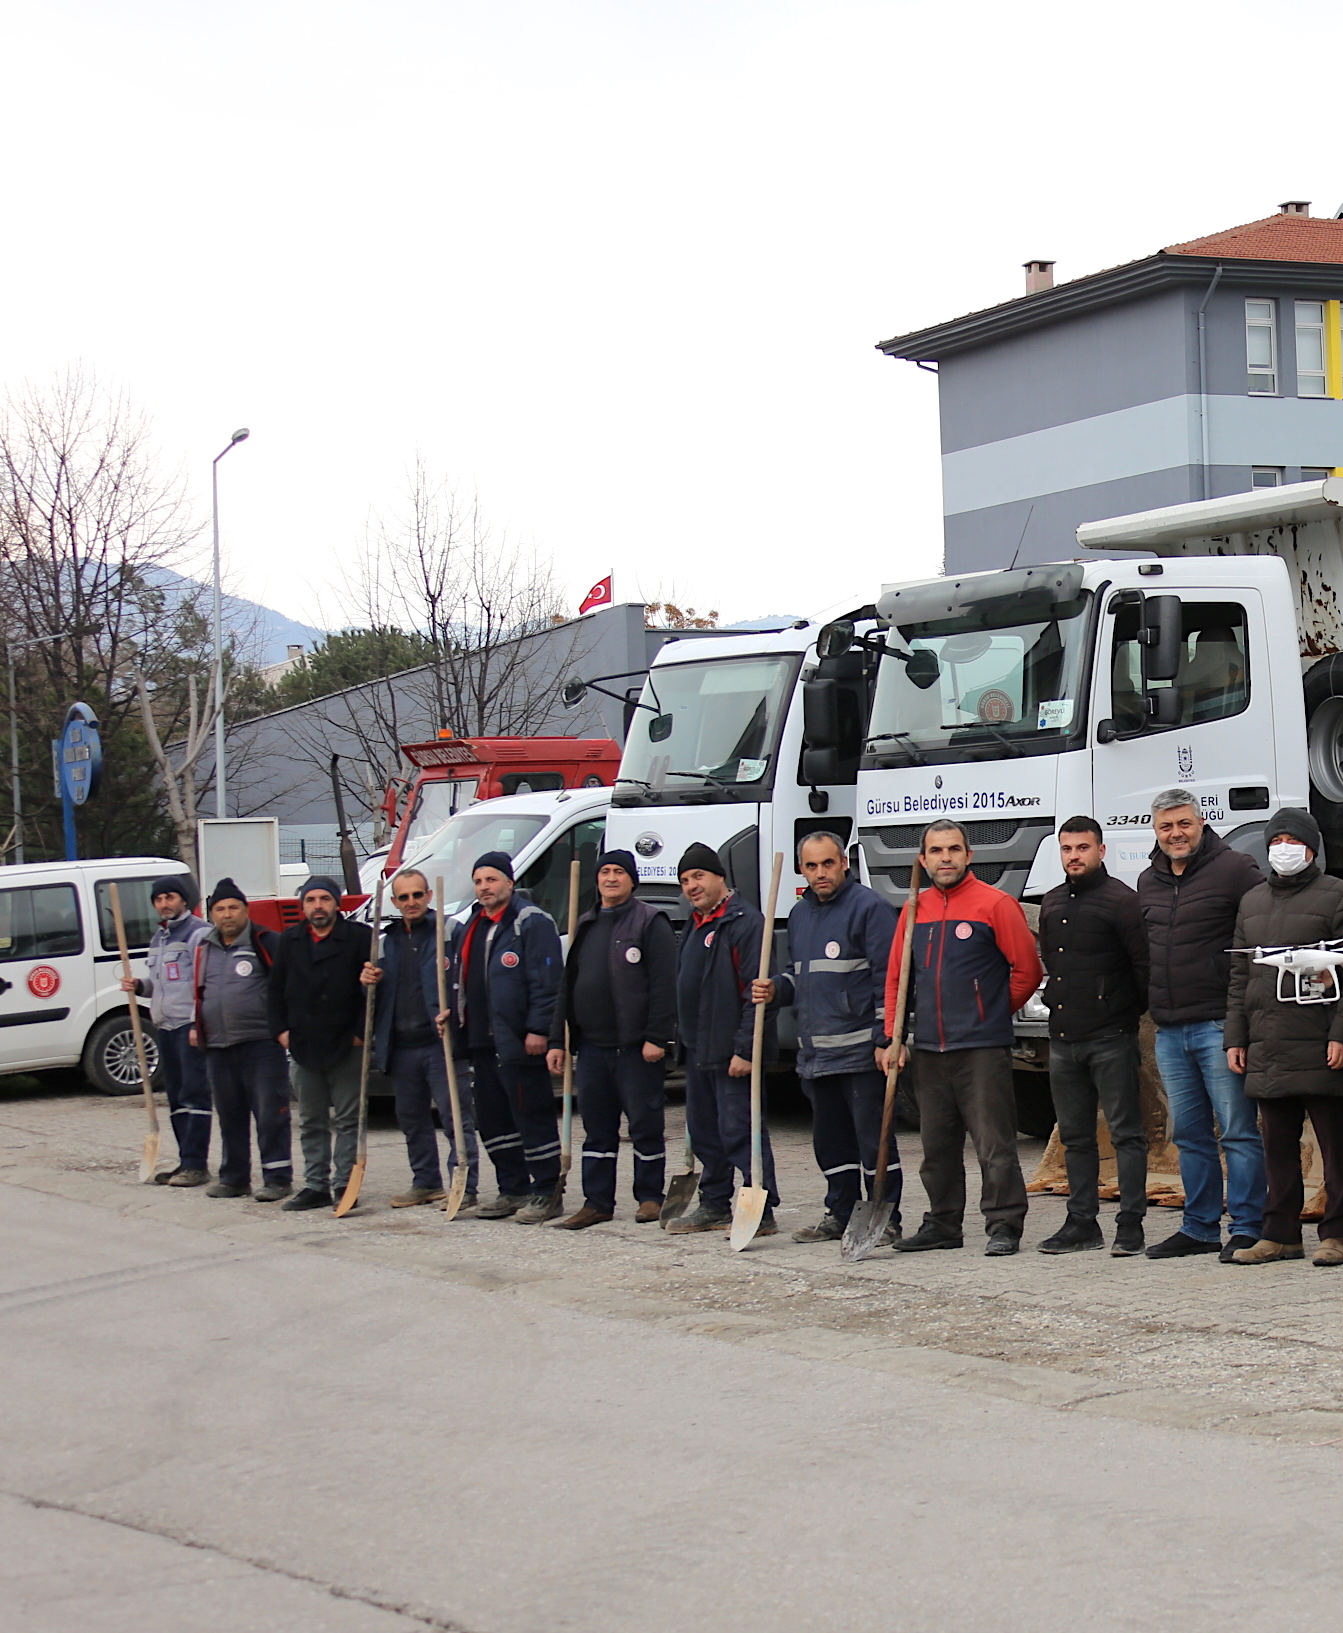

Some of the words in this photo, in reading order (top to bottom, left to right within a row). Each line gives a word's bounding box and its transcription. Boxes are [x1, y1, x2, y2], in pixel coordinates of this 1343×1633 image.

[866, 798, 900, 815] Gürsu
[903, 793, 969, 814] Belediyesi
[972, 791, 1005, 809] 2015
[1200, 794, 1219, 807] ERİ
[1106, 814, 1152, 826] 3340
[1129, 850, 1152, 860] BURS
[637, 866, 667, 876] ELEDİYESİ
[669, 866, 677, 876] 20
